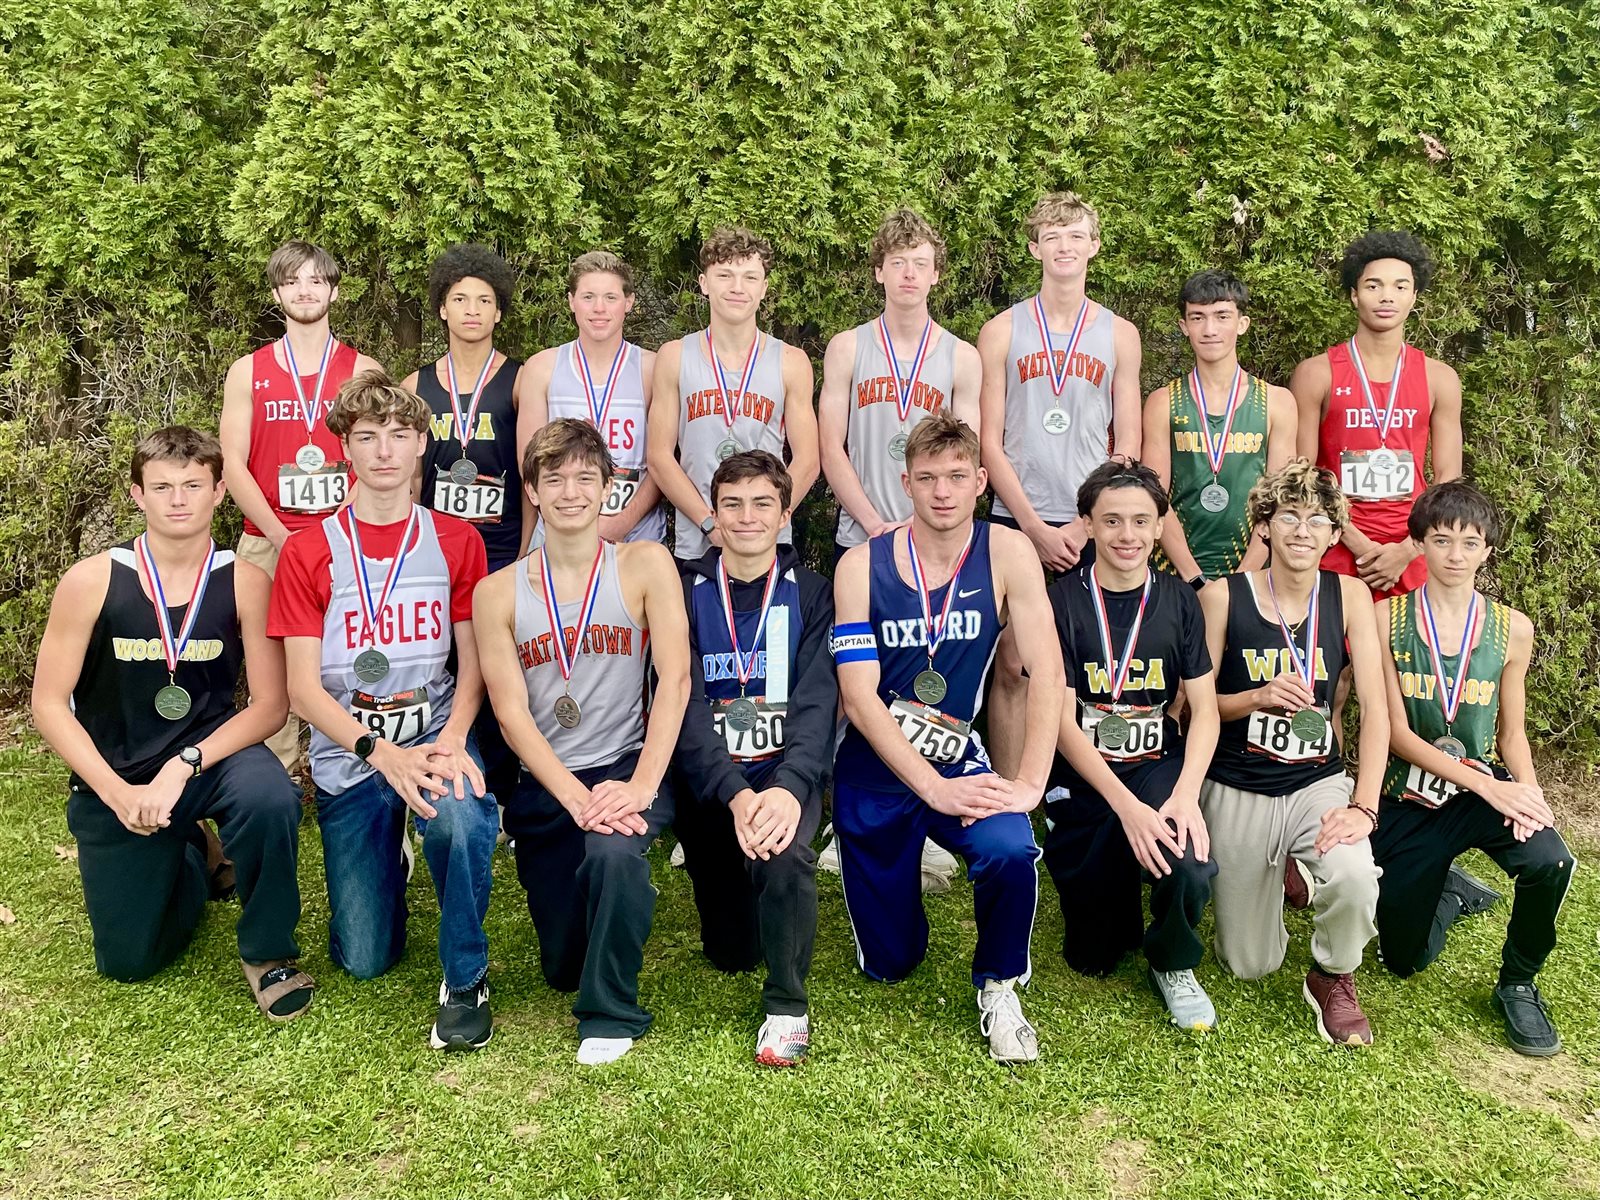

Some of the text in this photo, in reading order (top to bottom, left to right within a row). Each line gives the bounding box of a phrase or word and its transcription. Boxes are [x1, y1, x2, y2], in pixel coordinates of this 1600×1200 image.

[285, 475, 345, 506] 1413
[441, 485, 500, 514] 1812
[344, 600, 442, 649] EAGLES
[519, 624, 632, 670] WATRTOWN
[835, 637, 872, 649] CAPTAIN
[703, 651, 767, 681] OXFOR
[1084, 658, 1165, 694] WCA
[1397, 671, 1437, 700] OLY
[1089, 721, 1159, 754] 106
